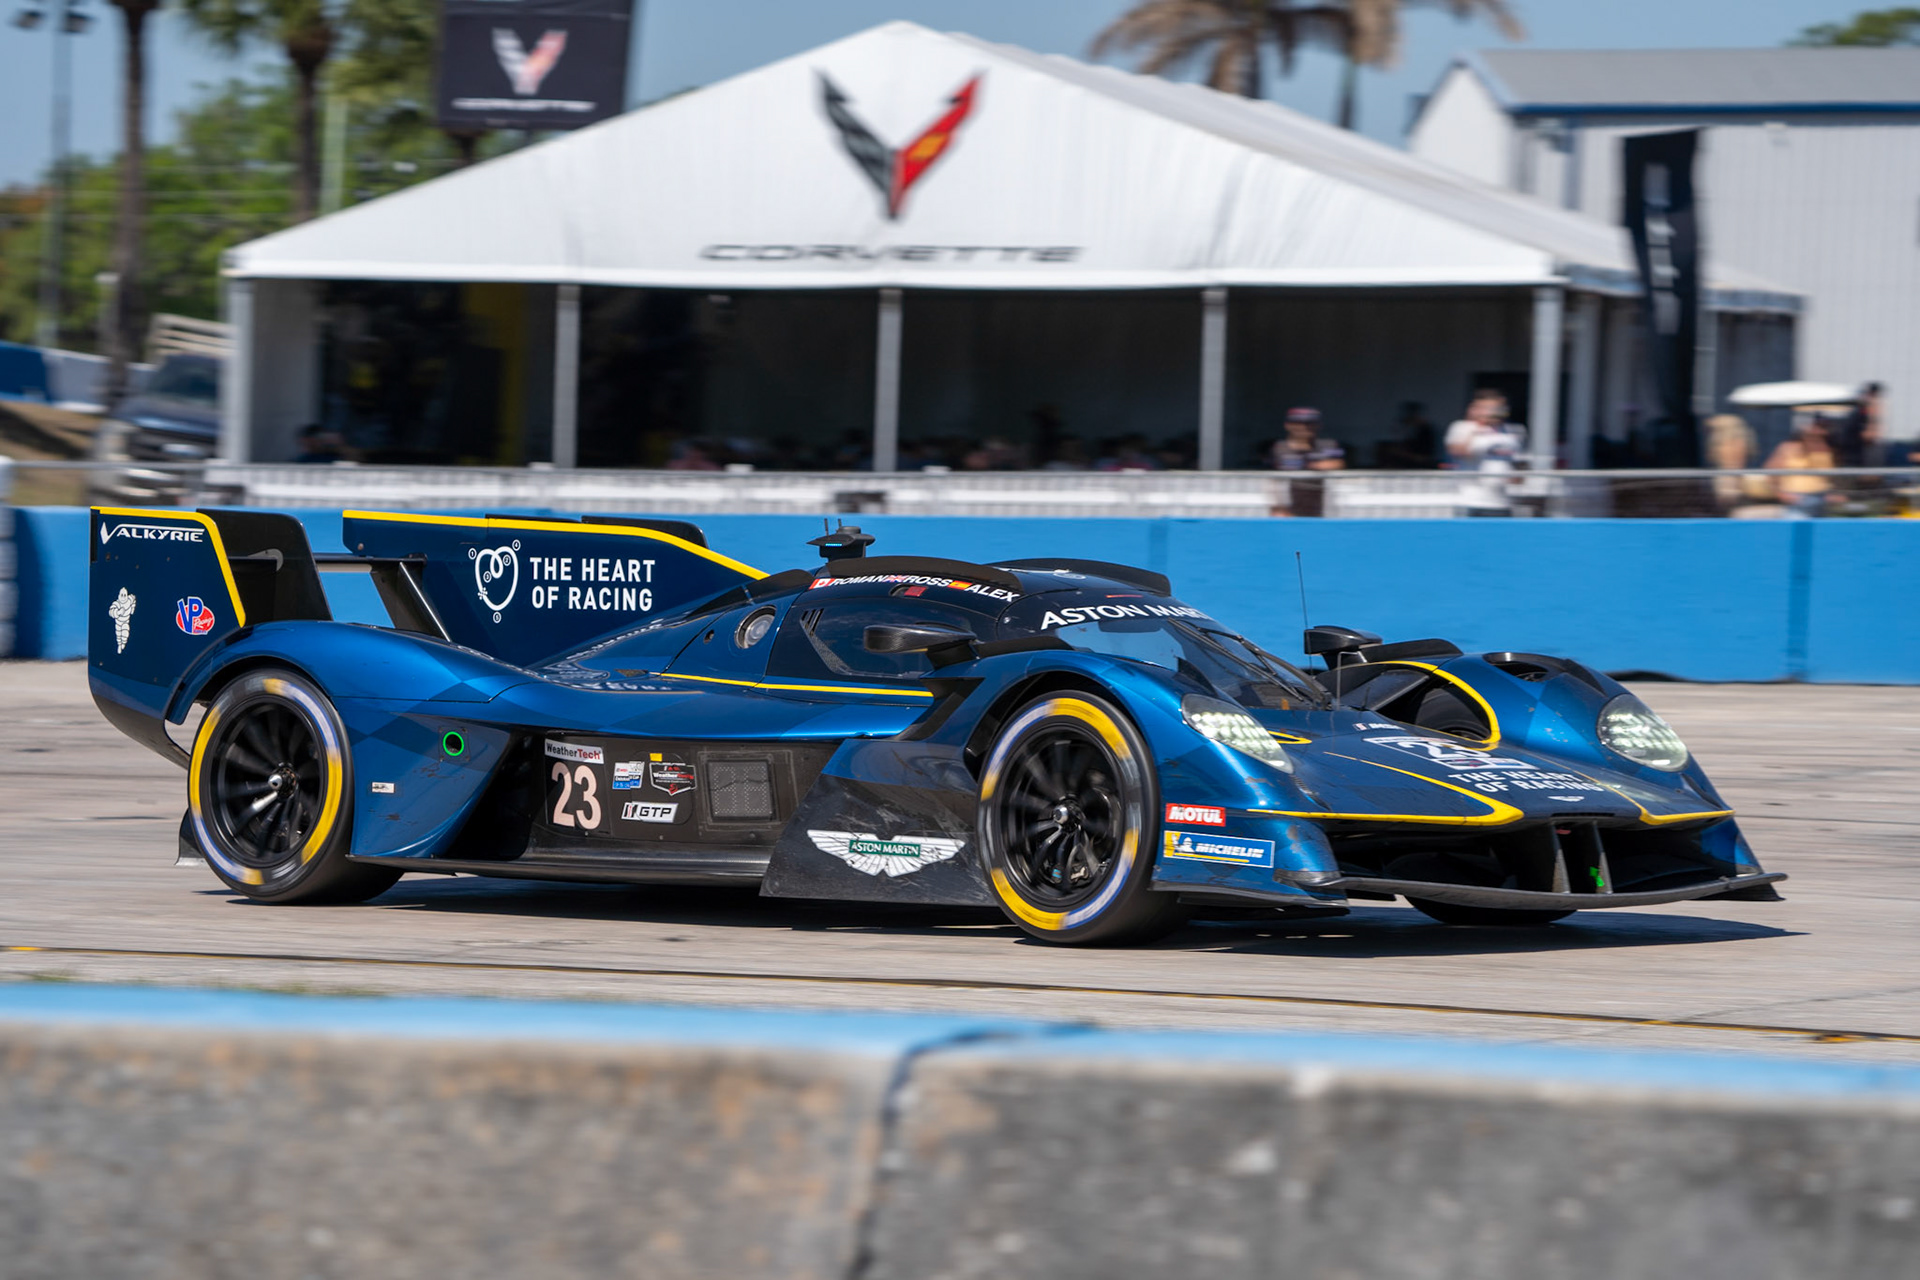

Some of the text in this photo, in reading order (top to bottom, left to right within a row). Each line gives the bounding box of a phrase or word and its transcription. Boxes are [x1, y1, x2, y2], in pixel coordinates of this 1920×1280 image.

[700, 244, 1083, 262] CORVETTE
[101, 522, 205, 544] VALKYRIE
[529, 557, 655, 582] THE HEART
[829, 575, 1020, 602] ROMAN ROSS ALEX
[531, 586, 653, 611] OF RACING
[177, 596, 204, 633] VP
[1041, 605, 1149, 630] ASTON
[546, 742, 601, 760] WeatherTech
[1448, 771, 1583, 783] THE HEART
[1474, 780, 1604, 792] OF RACING
[551, 761, 602, 830] 23
[640, 807, 672, 818] GTP
[1168, 806, 1223, 823] MOTUL
[851, 842, 919, 855] ASTON MARTIN
[1195, 843, 1265, 858] MICHELIN
